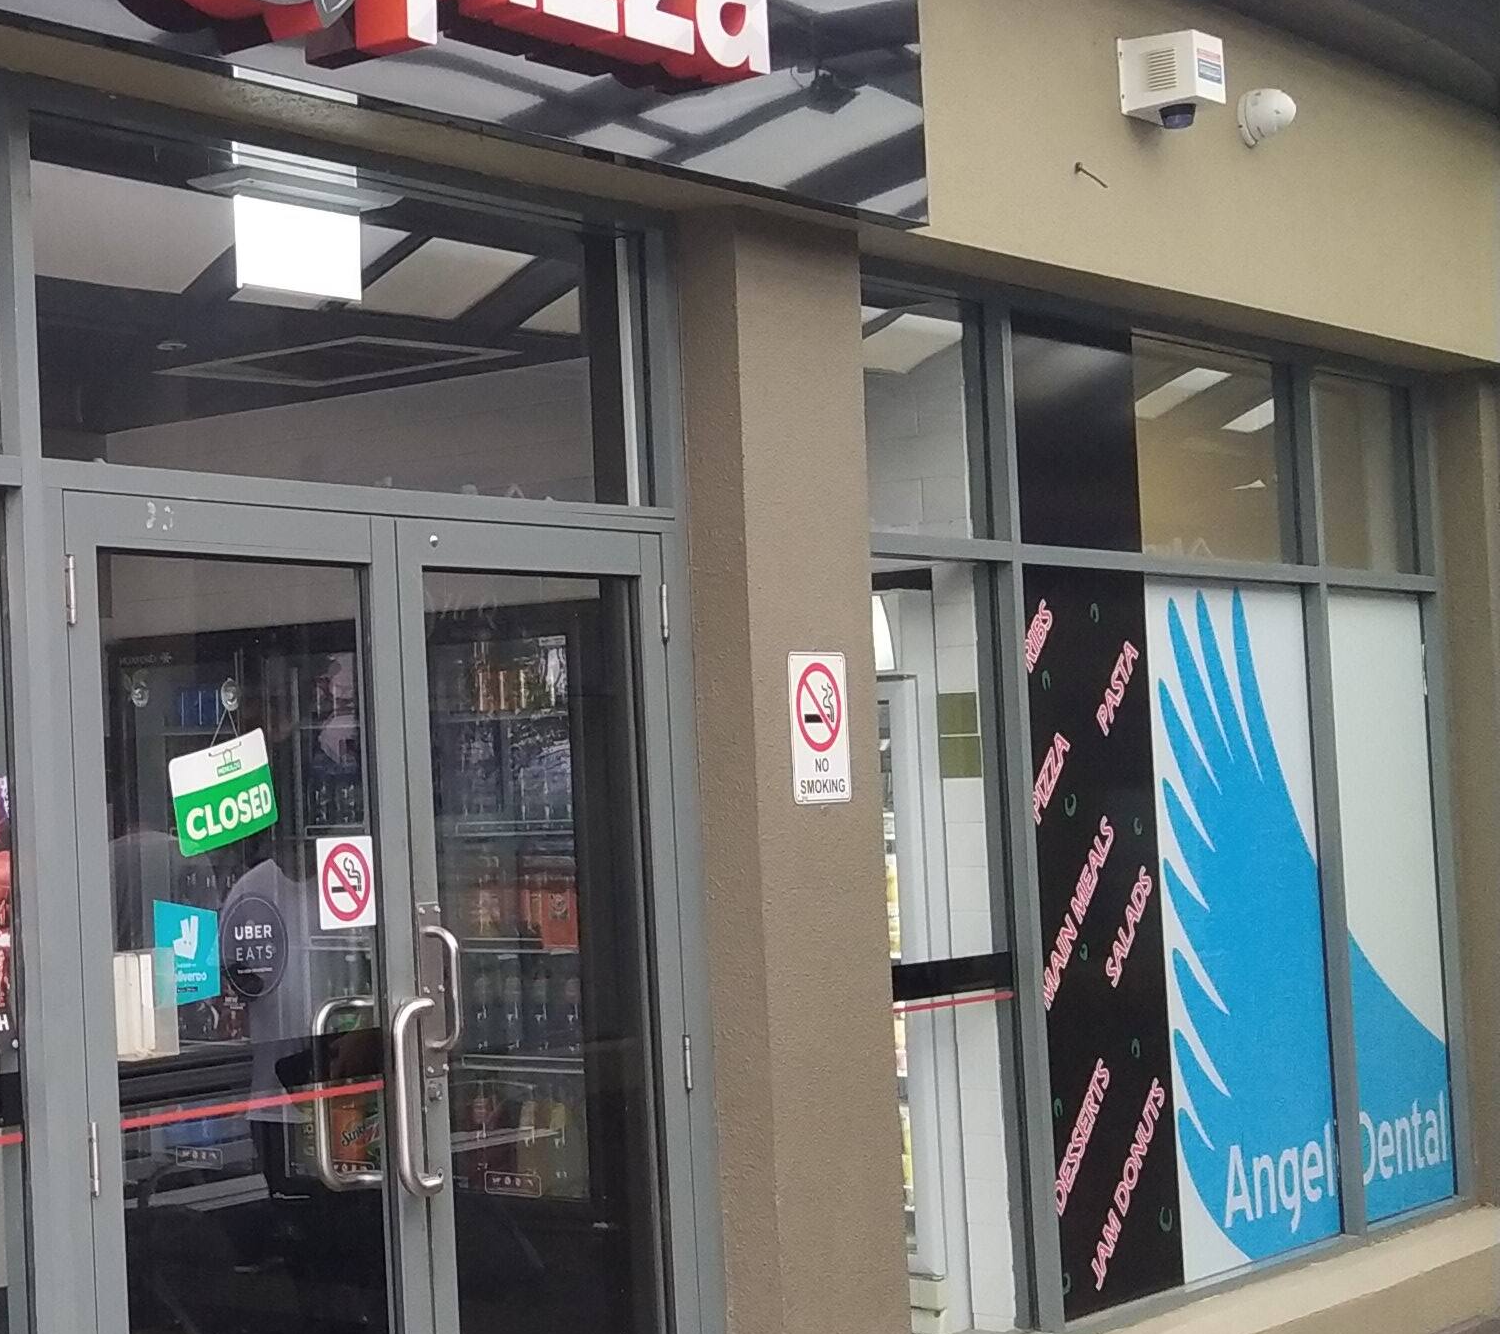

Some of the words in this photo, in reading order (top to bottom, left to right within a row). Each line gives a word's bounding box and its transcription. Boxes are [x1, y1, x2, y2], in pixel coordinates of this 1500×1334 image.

[1025, 598, 1052, 673] RIBS
[1096, 640, 1139, 736] PASTA
[186, 782, 272, 840] CLOSED
[800, 778, 846, 795] SMOKING
[814, 757, 830, 773] NO
[1033, 732, 1070, 825] PIZZA
[234, 924, 273, 940] UBER
[235, 945, 273, 962] EATS
[1043, 913, 1077, 1011] MAIN
[1070, 815, 1114, 925] MEALS
[1106, 865, 1152, 988] SALADS
[1054, 1057, 1110, 1216] DESSERTS
[1225, 1118, 1335, 1233] Angel
[1359, 1090, 1447, 1186] Dental
[1091, 1208, 1122, 1291] JAM
[1114, 1077, 1165, 1217] DONUTS
